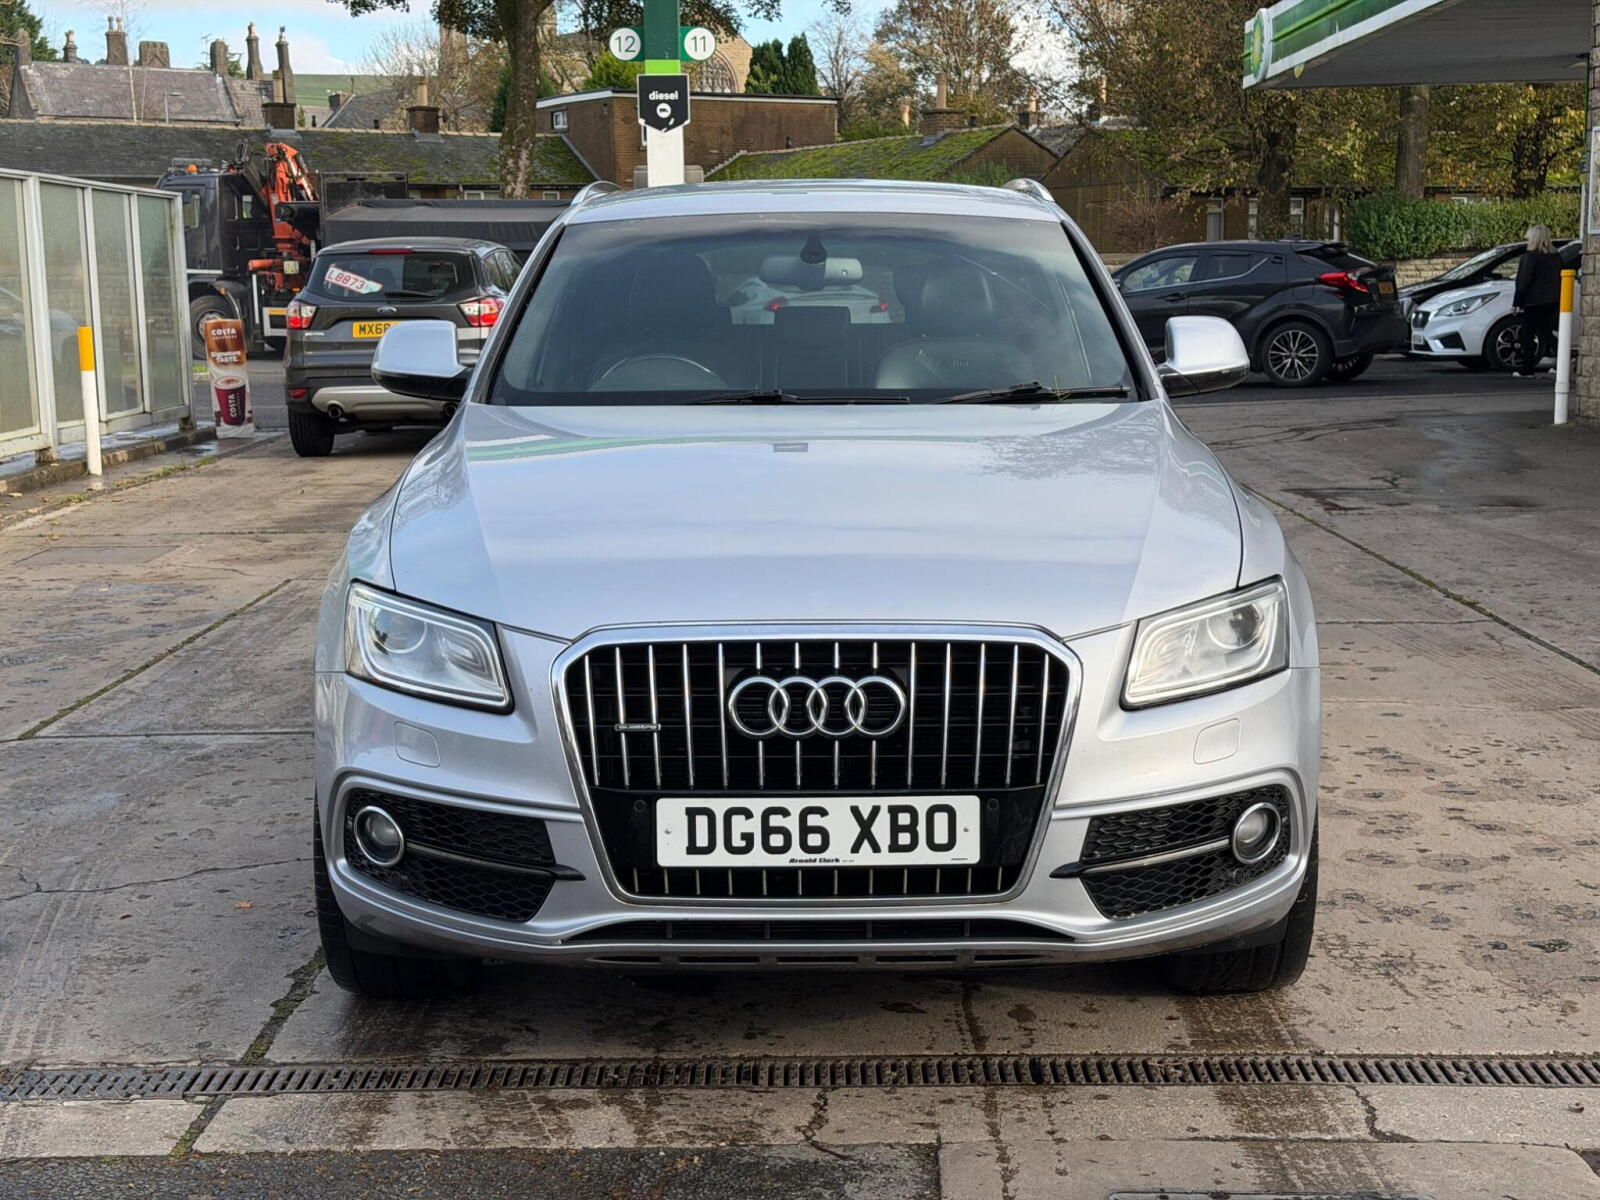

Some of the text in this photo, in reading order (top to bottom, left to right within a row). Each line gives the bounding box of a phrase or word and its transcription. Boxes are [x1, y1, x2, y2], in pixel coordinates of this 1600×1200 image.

[615, 36, 636, 53] 12
[691, 36, 706, 53] 11
[648, 91, 679, 101] diesel
[211, 328, 236, 336] COSTA
[229, 394, 237, 417] COSTA
[685, 803, 958, 856] DG66 XBO
